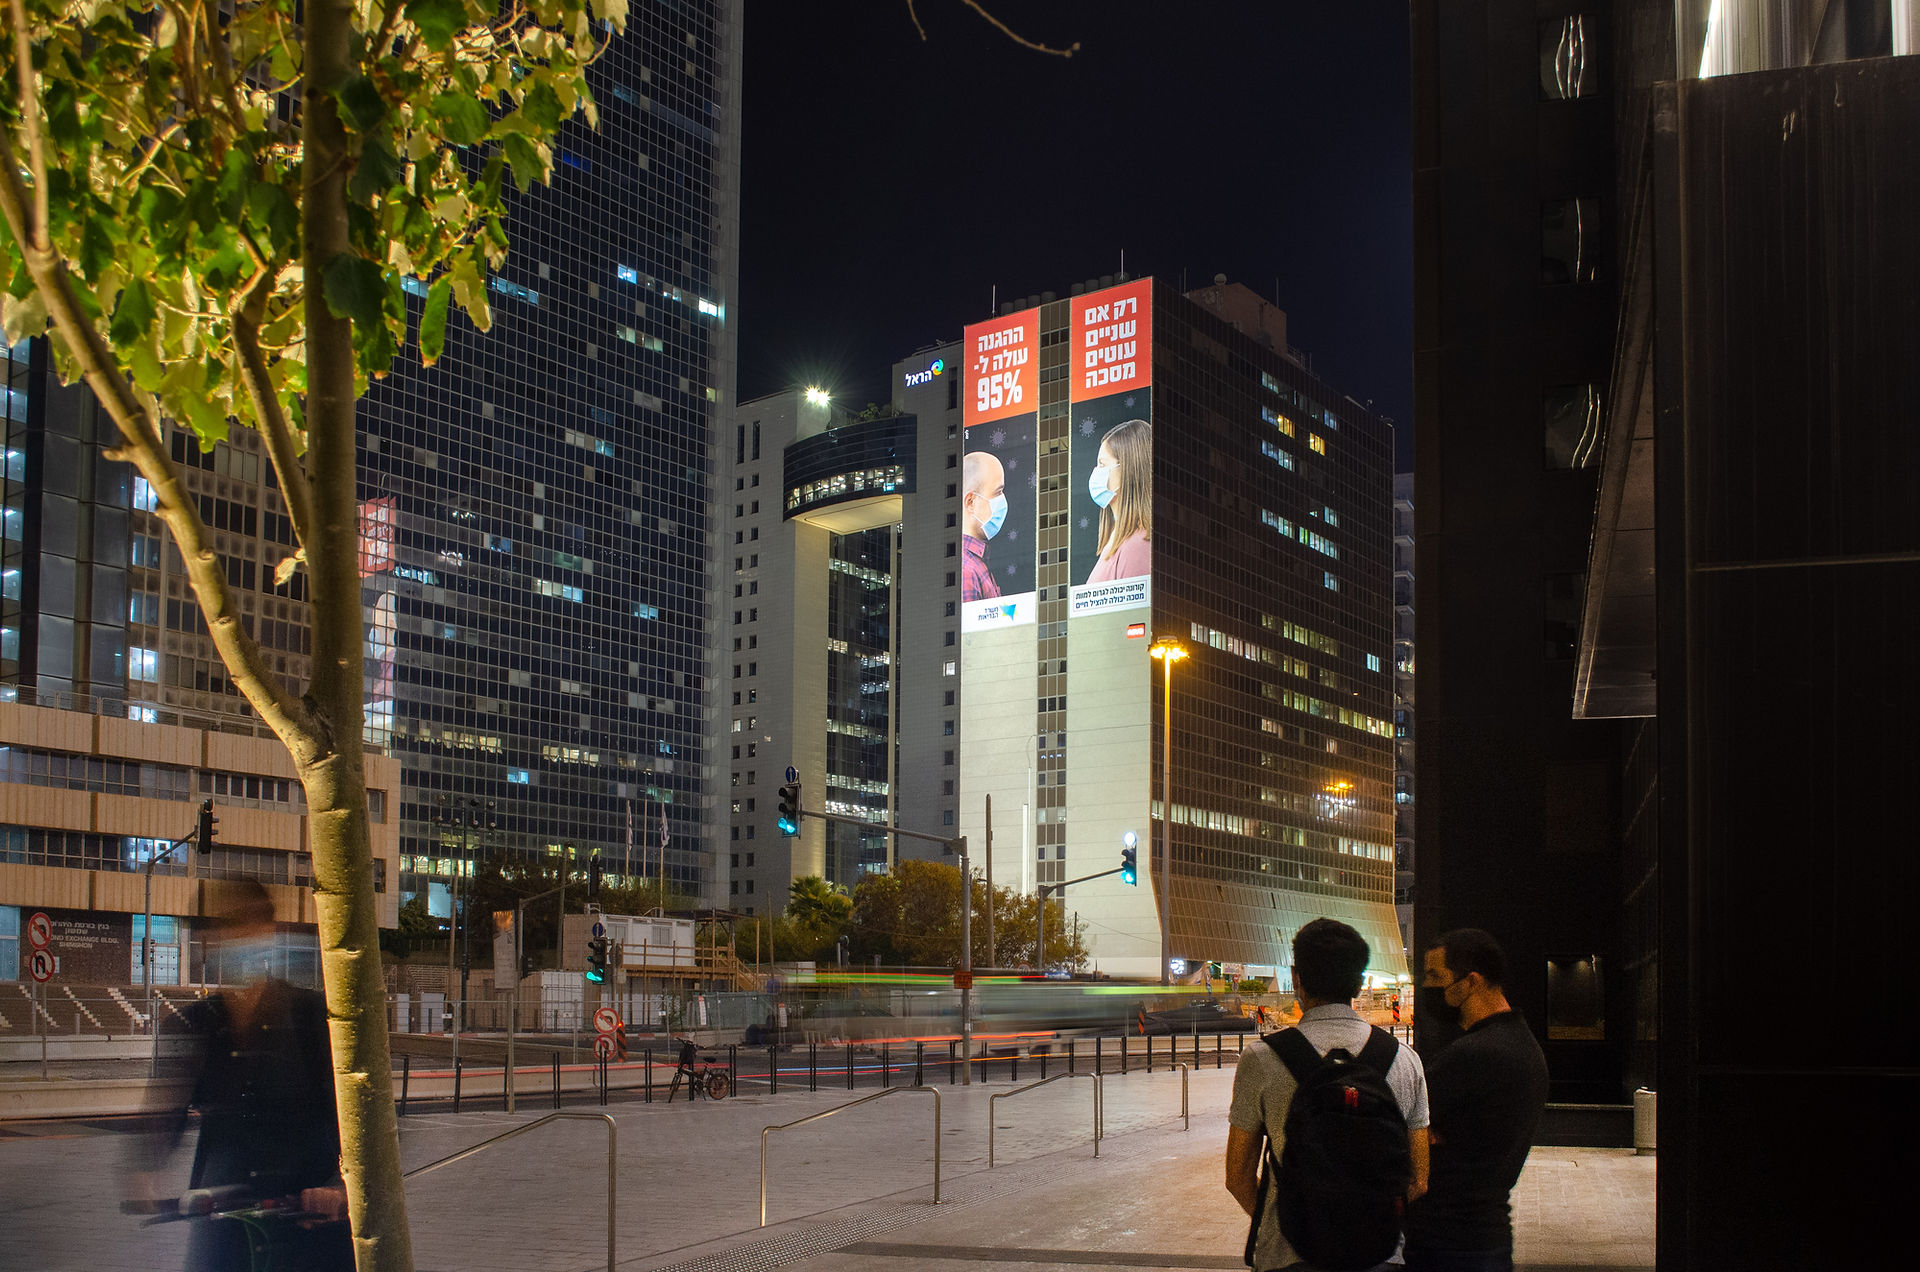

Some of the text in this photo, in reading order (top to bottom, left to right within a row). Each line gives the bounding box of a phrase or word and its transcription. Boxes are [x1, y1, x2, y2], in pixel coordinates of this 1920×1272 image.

[1085, 297, 1137, 326] רק אם
[978, 326, 1024, 353] ההגנה
[1085, 320, 1136, 348] שניים
[993, 347, 1028, 372] עולה
[1085, 340, 1136, 368] עוטים
[905, 370, 932, 387] הראל
[1085, 361, 1135, 389] מסכה
[977, 369, 1023, 412] 95%
[1075, 583, 1145, 600] קורונה יכולה לגרום למוות
[1075, 592, 1145, 609] מסכה יכולה להציל חיים
[65, 935, 100, 943] EXCHANGE
